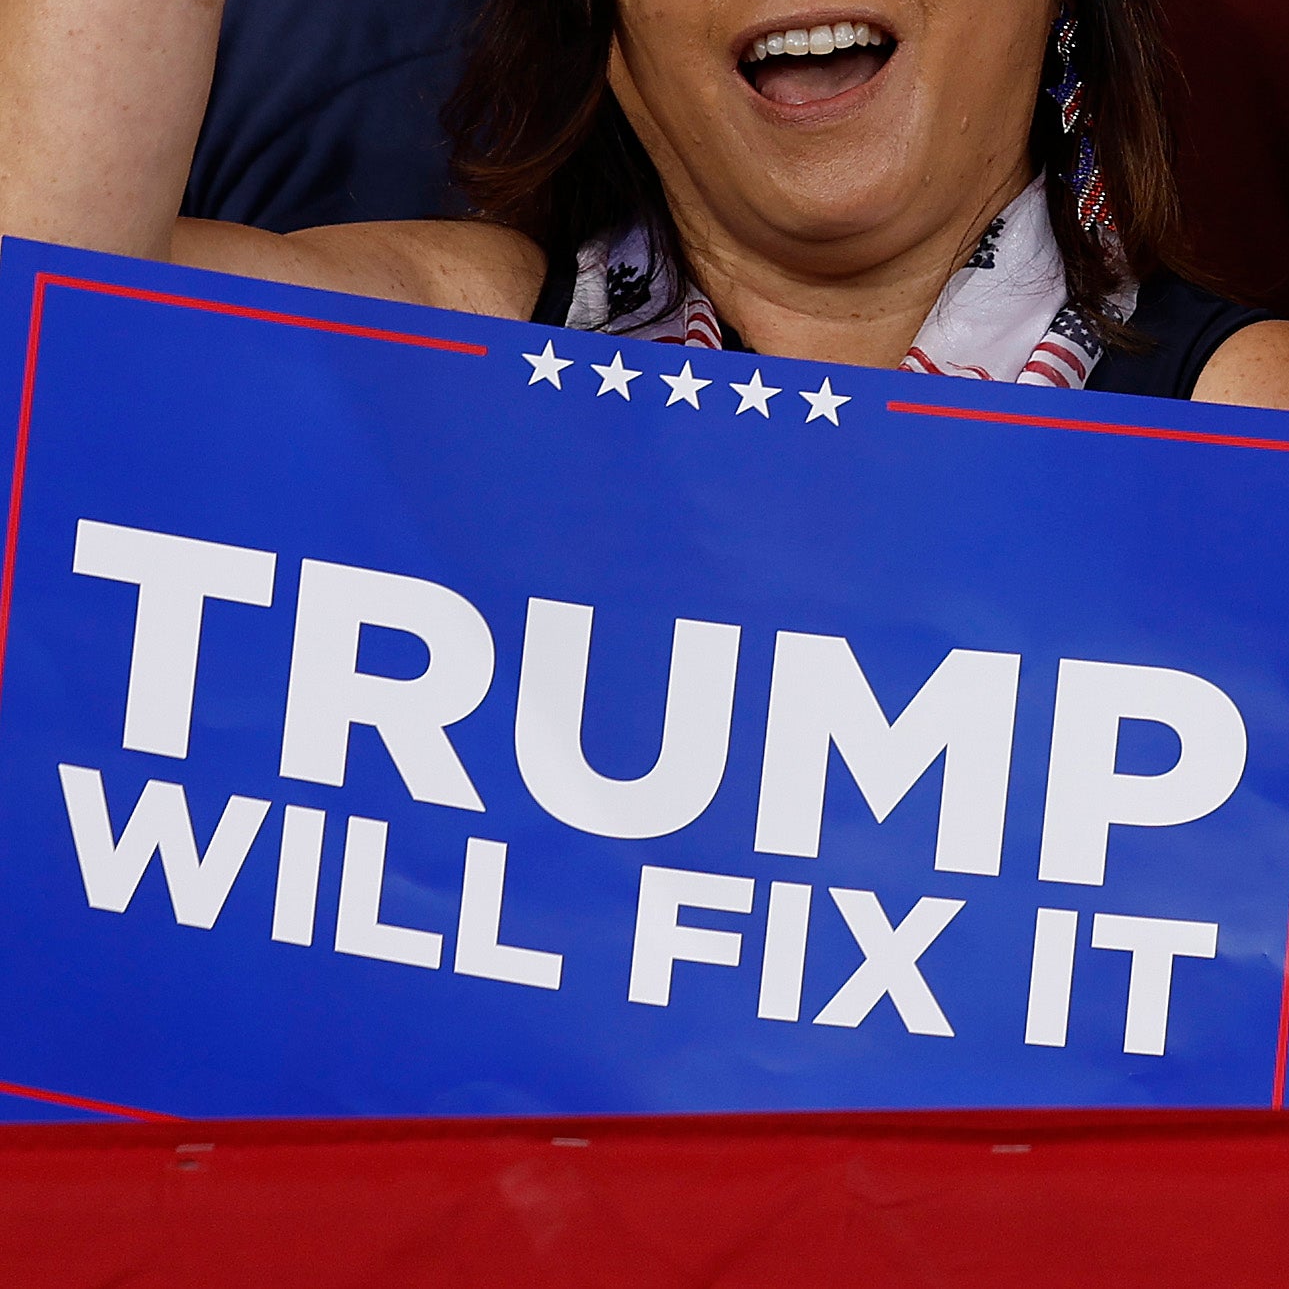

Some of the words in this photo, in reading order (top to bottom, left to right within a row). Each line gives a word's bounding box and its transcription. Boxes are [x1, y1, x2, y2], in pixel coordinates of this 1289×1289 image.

[72, 518, 1247, 886] TRUMP
[58, 763, 563, 990] WILL
[628, 865, 967, 1038] FIX
[1024, 907, 1219, 1056] IT
